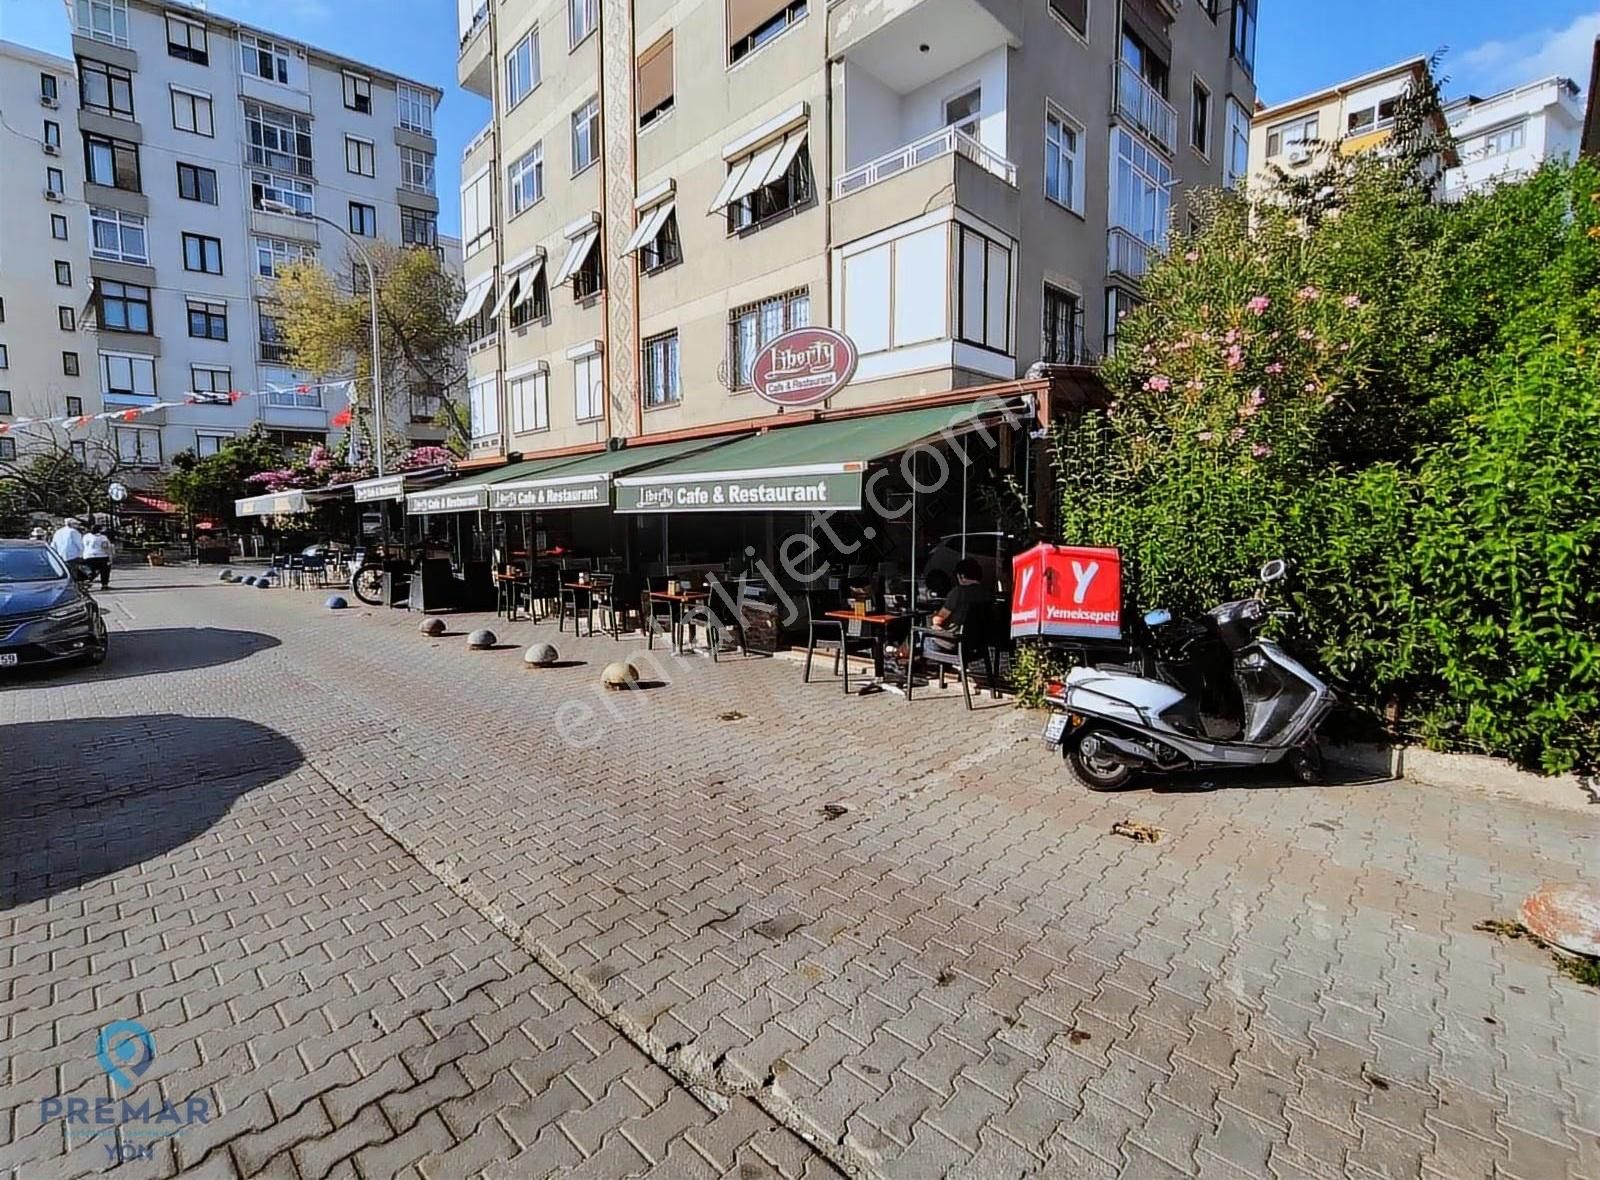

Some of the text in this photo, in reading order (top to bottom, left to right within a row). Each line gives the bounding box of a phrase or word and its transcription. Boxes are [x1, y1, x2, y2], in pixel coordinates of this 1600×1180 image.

[765, 341, 836, 380] Liberty
[767, 382, 785, 394] Cafe
[792, 374, 833, 388] Restaurant
[517, 491, 536, 504] Cafe
[546, 486, 598, 503] Restaurant
[636, 481, 827, 508] Liberty Cafe & Restaurant
[1071, 560, 1100, 604] Y
[1046, 605, 1120, 622] Yemeksepeti
